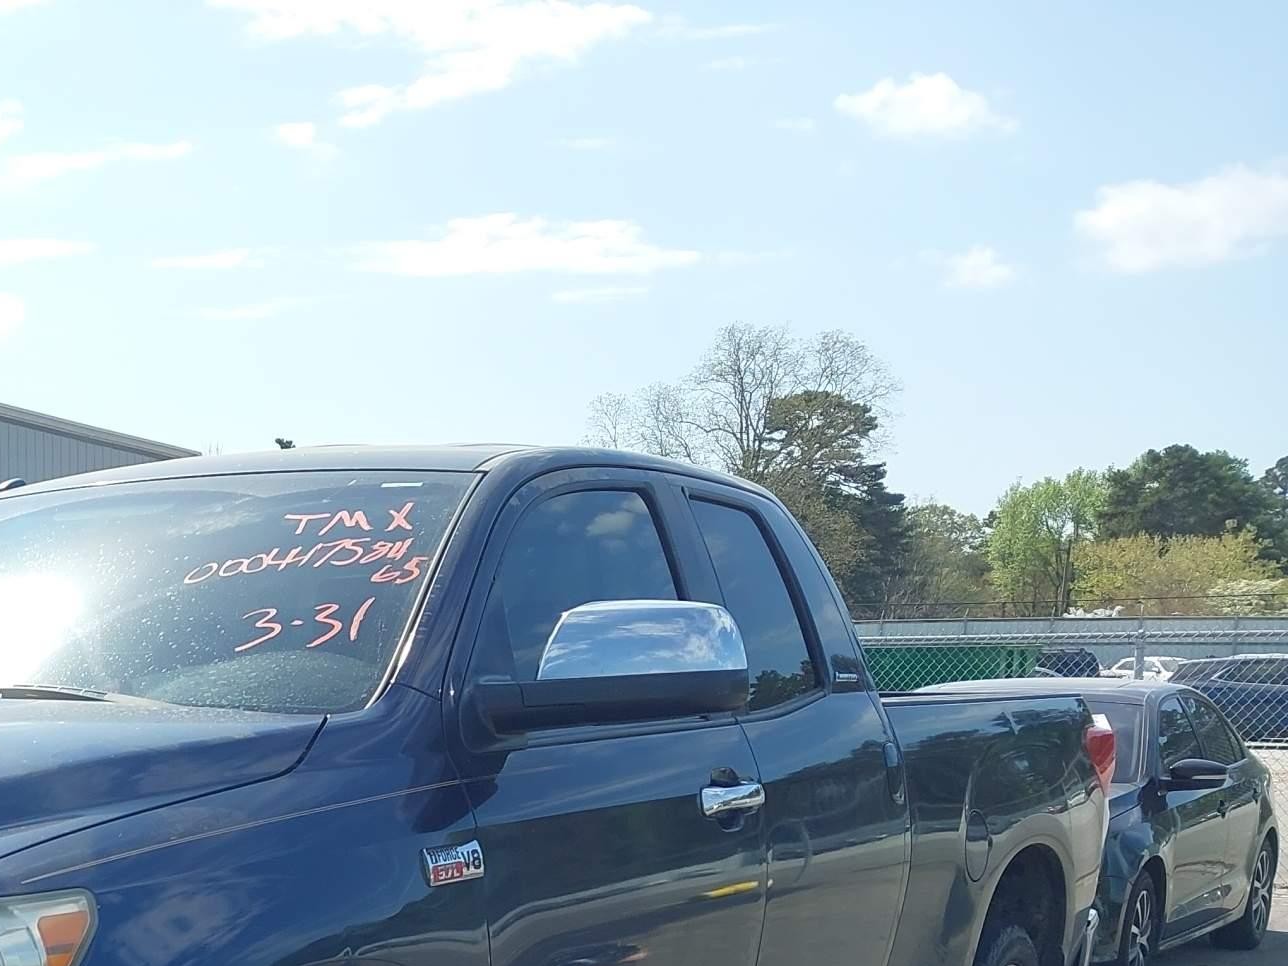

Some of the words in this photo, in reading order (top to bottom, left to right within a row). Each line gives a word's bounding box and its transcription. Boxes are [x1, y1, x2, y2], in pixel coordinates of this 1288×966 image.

[370, 556, 429, 584] 65
[234, 596, 376, 652] 3-31
[461, 848, 482, 872] V8
